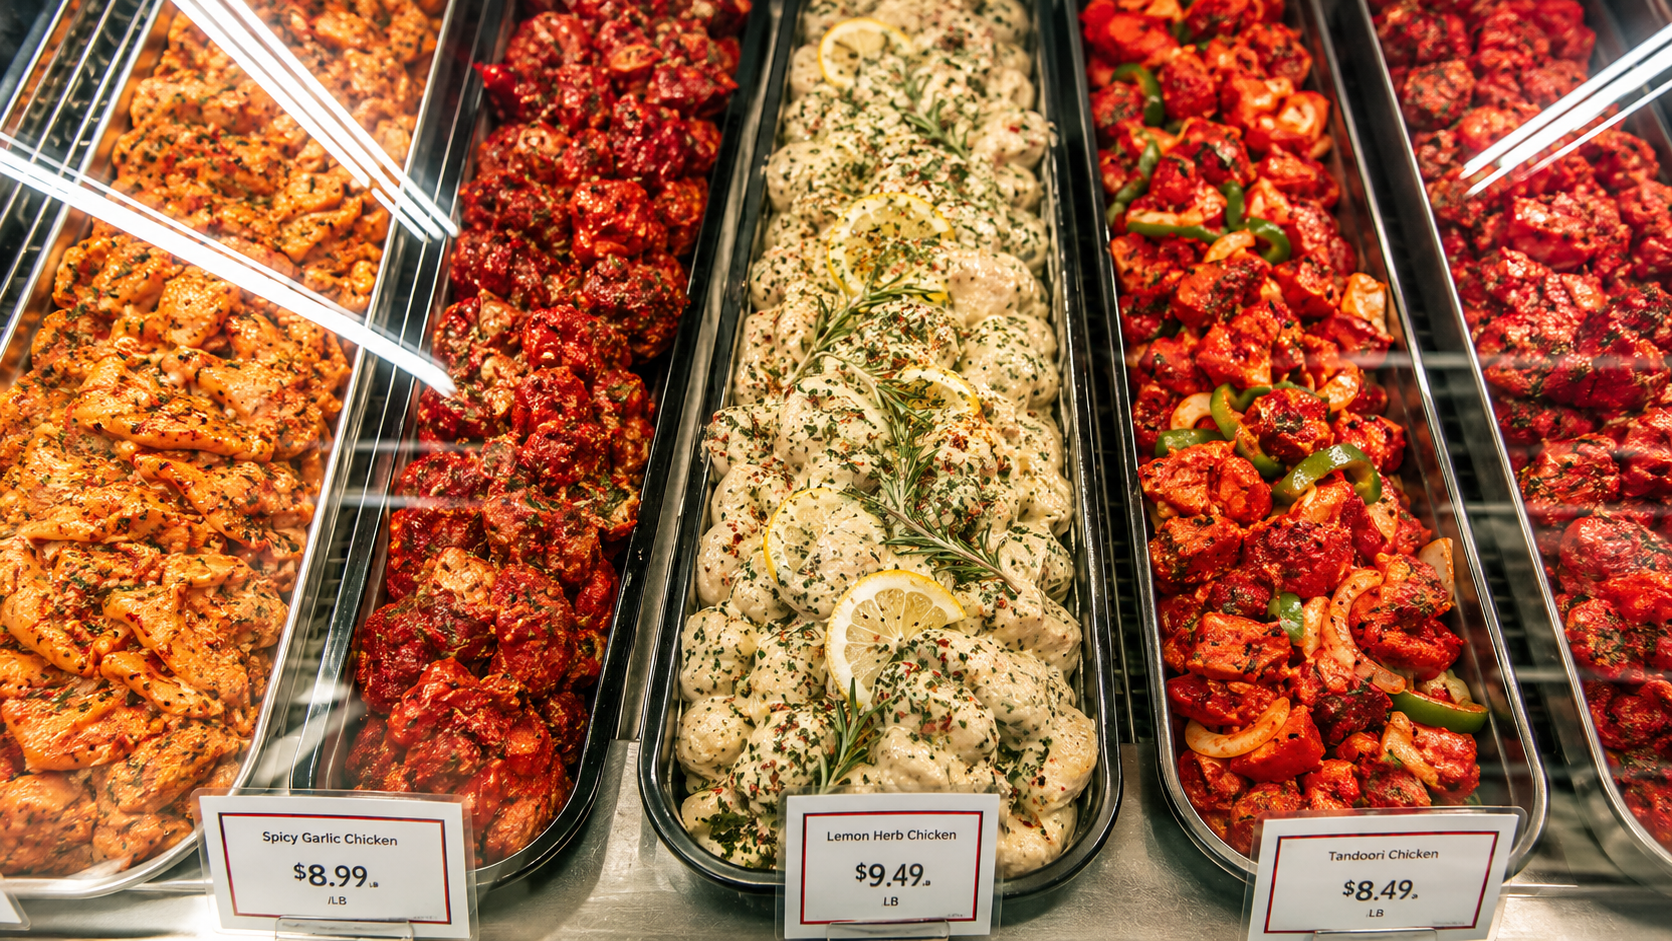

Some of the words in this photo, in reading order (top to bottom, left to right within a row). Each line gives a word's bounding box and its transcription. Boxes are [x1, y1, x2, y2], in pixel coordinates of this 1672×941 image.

[262, 831, 298, 845] Spicy
[302, 832, 341, 844] Garlic
[344, 833, 398, 846] Chicken
[827, 831, 869, 842] Lemon
[874, 830, 904, 841] Herb
[907, 829, 957, 841] Chicken
[1328, 850, 1385, 862] Tandoori
[1388, 849, 1439, 861] Chicken
[293, 862, 368, 887] $8.99
[855, 862, 924, 887] $9.49
[1343, 879, 1413, 901] $8.49
[328, 896, 347, 906] /LB
